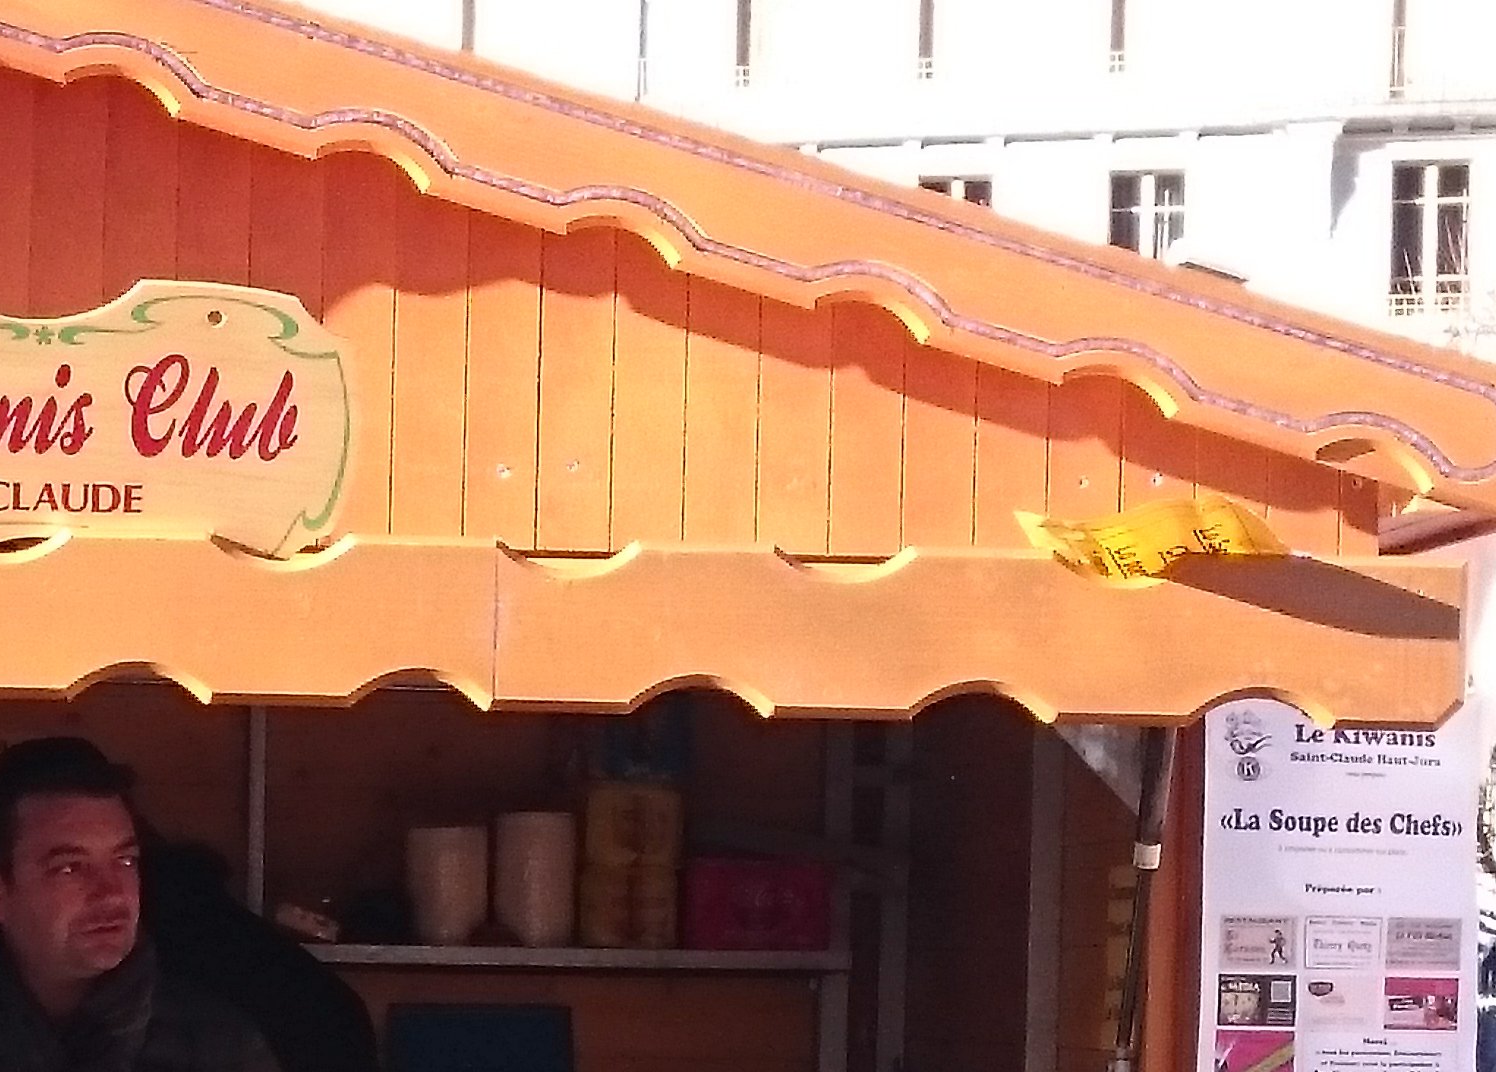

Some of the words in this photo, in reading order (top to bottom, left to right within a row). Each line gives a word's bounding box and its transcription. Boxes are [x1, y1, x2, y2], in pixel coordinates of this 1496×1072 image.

[124, 353, 298, 461] Club
[1295, 724, 1324, 743] Le
[1290, 752, 1372, 764] Saint-Claude
[1269, 809, 1339, 837] Soupe
[1346, 812, 1382, 834] des
